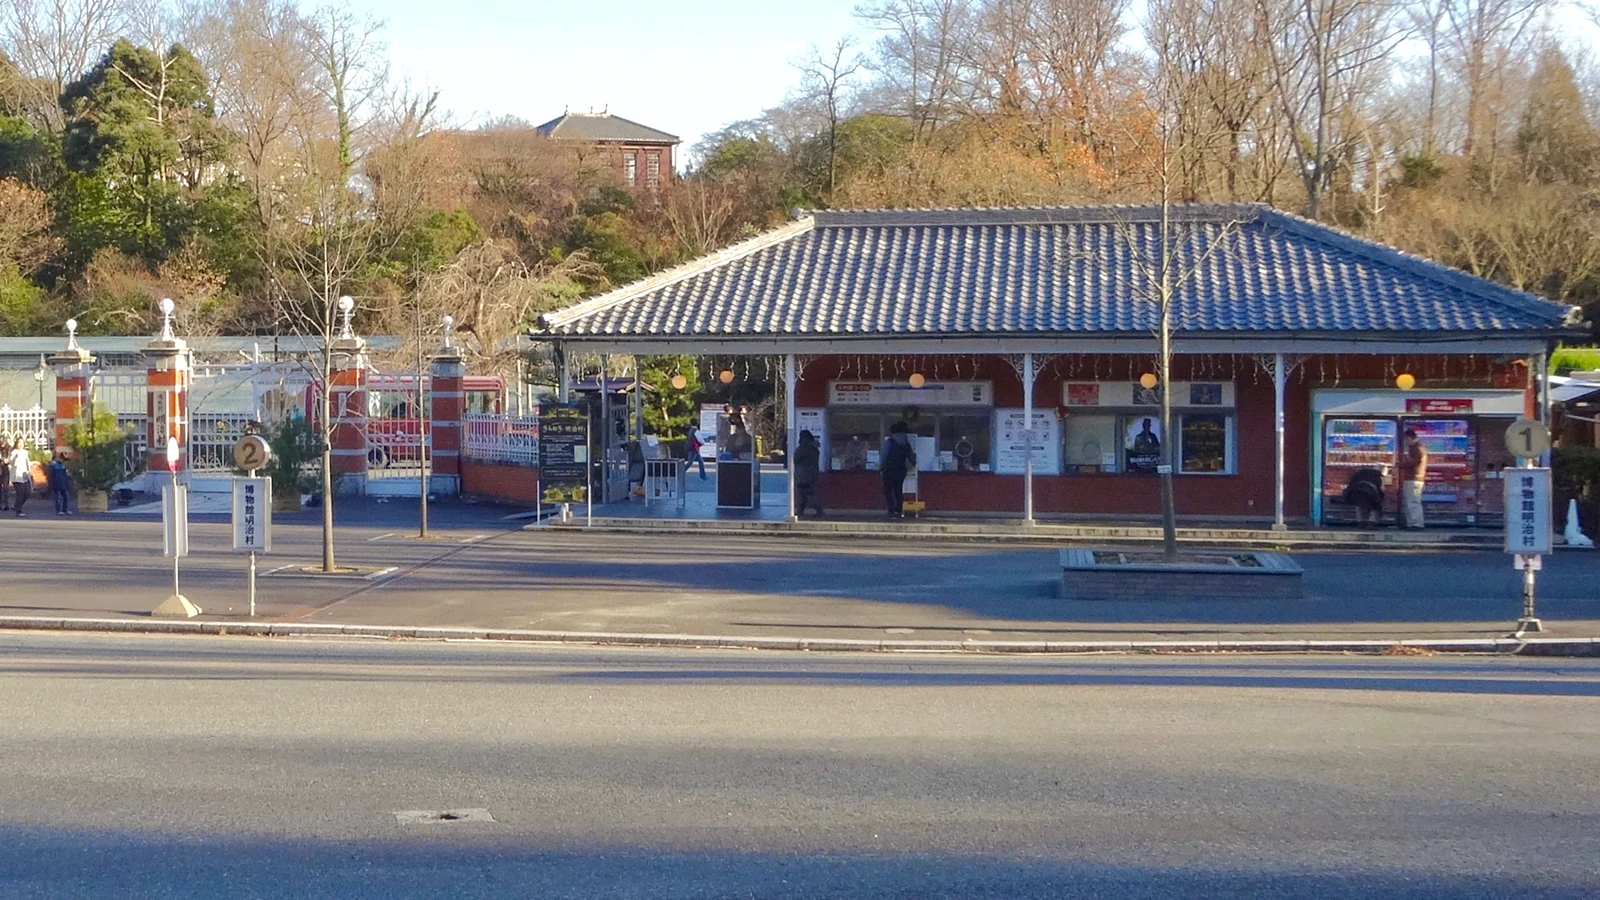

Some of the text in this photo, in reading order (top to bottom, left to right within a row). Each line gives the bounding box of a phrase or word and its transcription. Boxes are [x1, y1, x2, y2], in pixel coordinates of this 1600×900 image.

[242, 442, 258, 465] 2
[1518, 427, 1532, 451] 1
[245, 484, 254, 546] 博物館明治村
[1521, 476, 1535, 547] 博物館明治村
